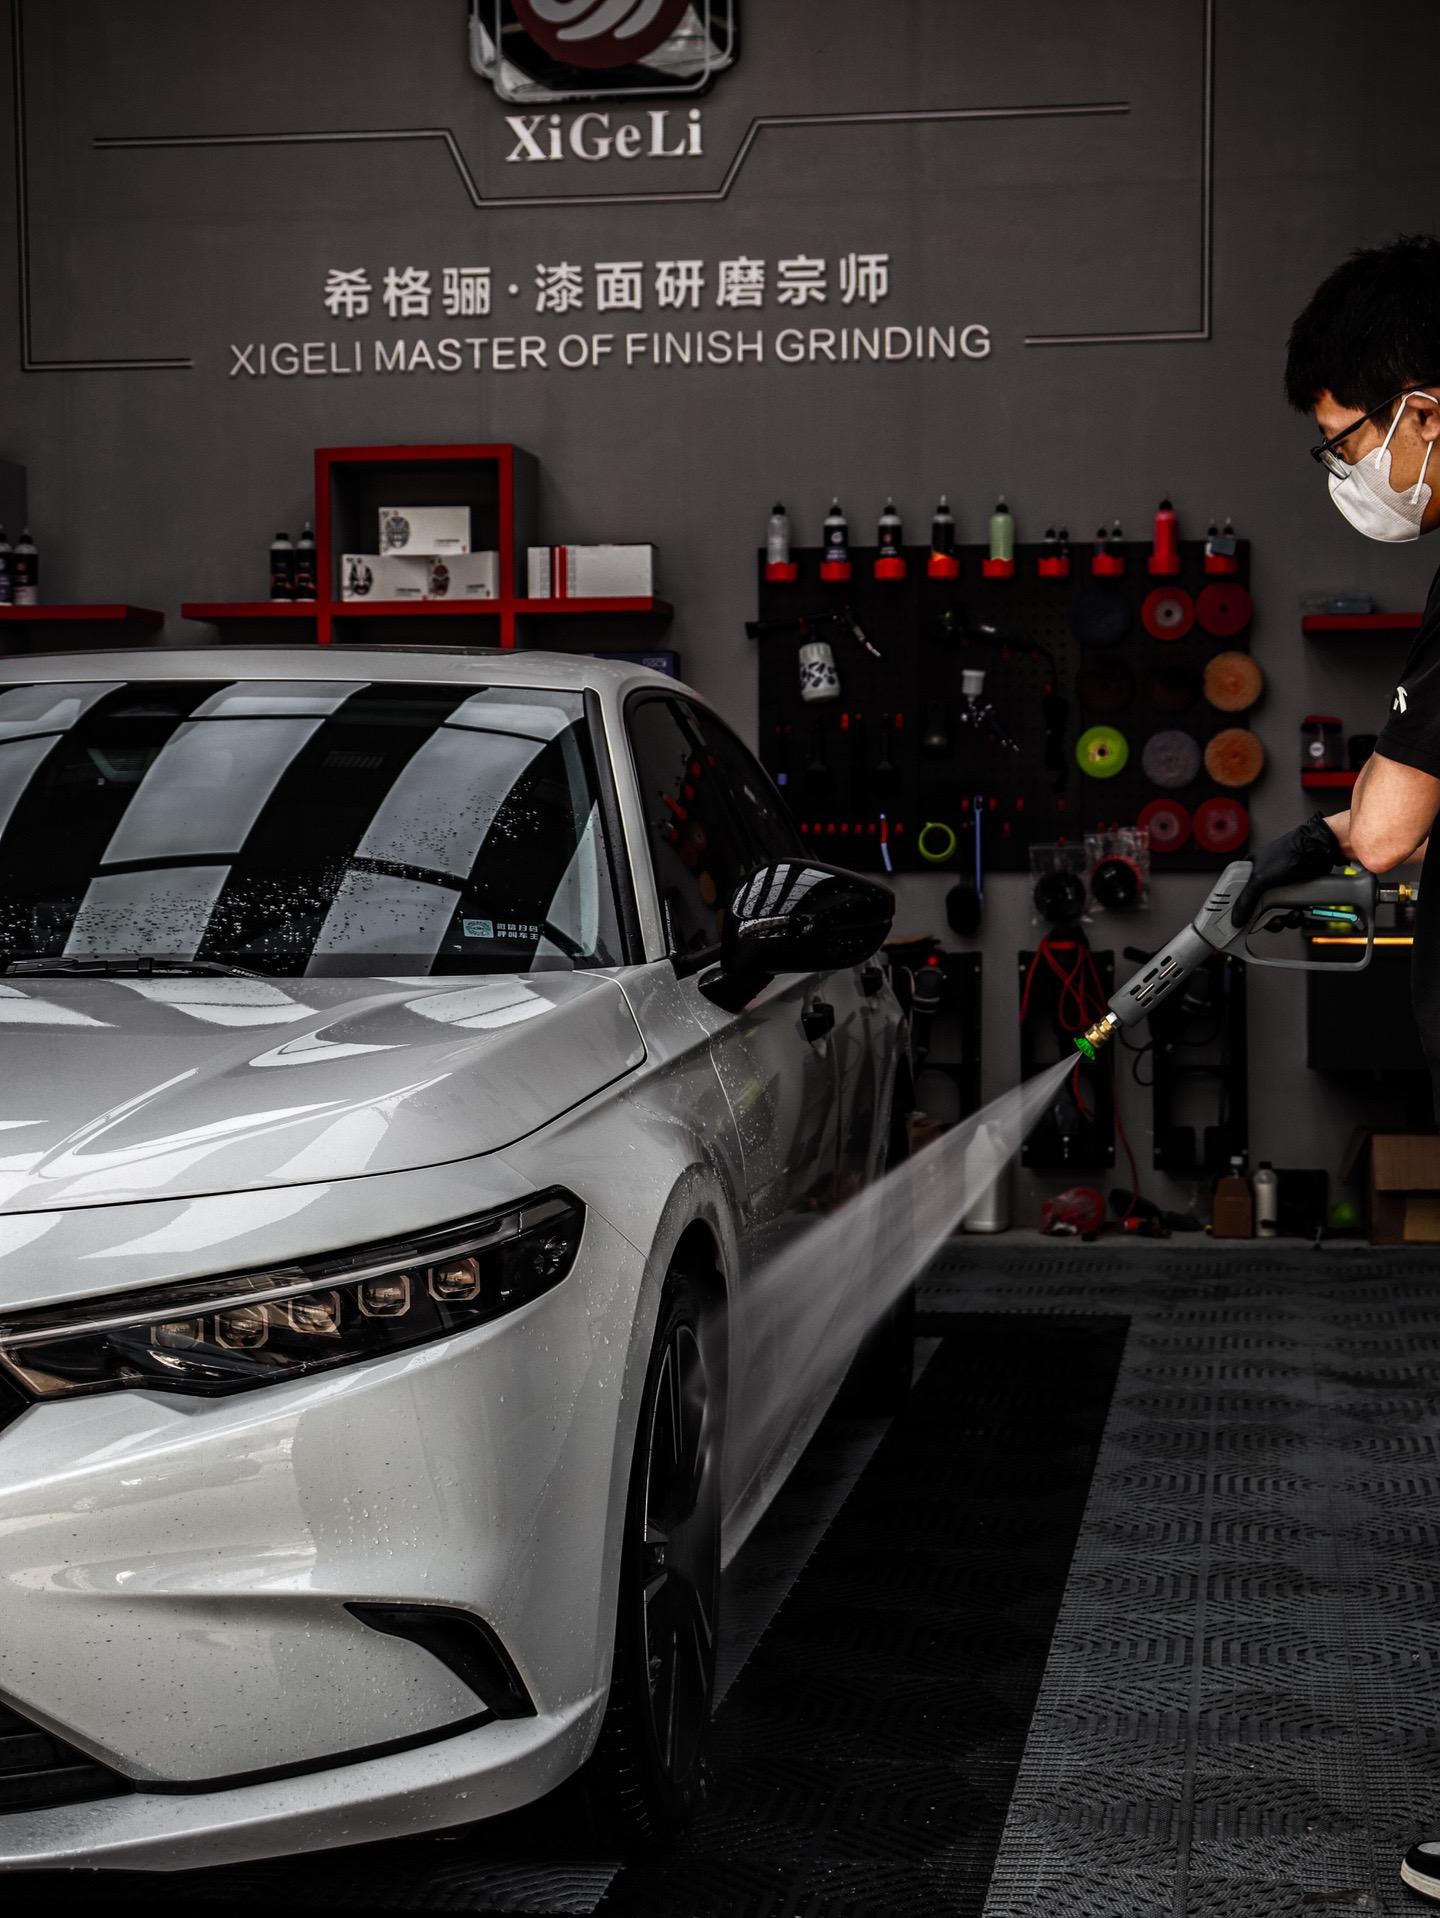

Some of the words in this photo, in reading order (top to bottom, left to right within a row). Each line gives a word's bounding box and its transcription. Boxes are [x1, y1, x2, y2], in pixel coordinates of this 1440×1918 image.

[504, 108, 703, 162] XiGeLi
[229, 341, 363, 376] XIGELI
[374, 336, 548, 372] MASTER
[558, 333, 614, 368] OF
[626, 329, 763, 365] FINISH
[775, 324, 991, 362] GRINDING
